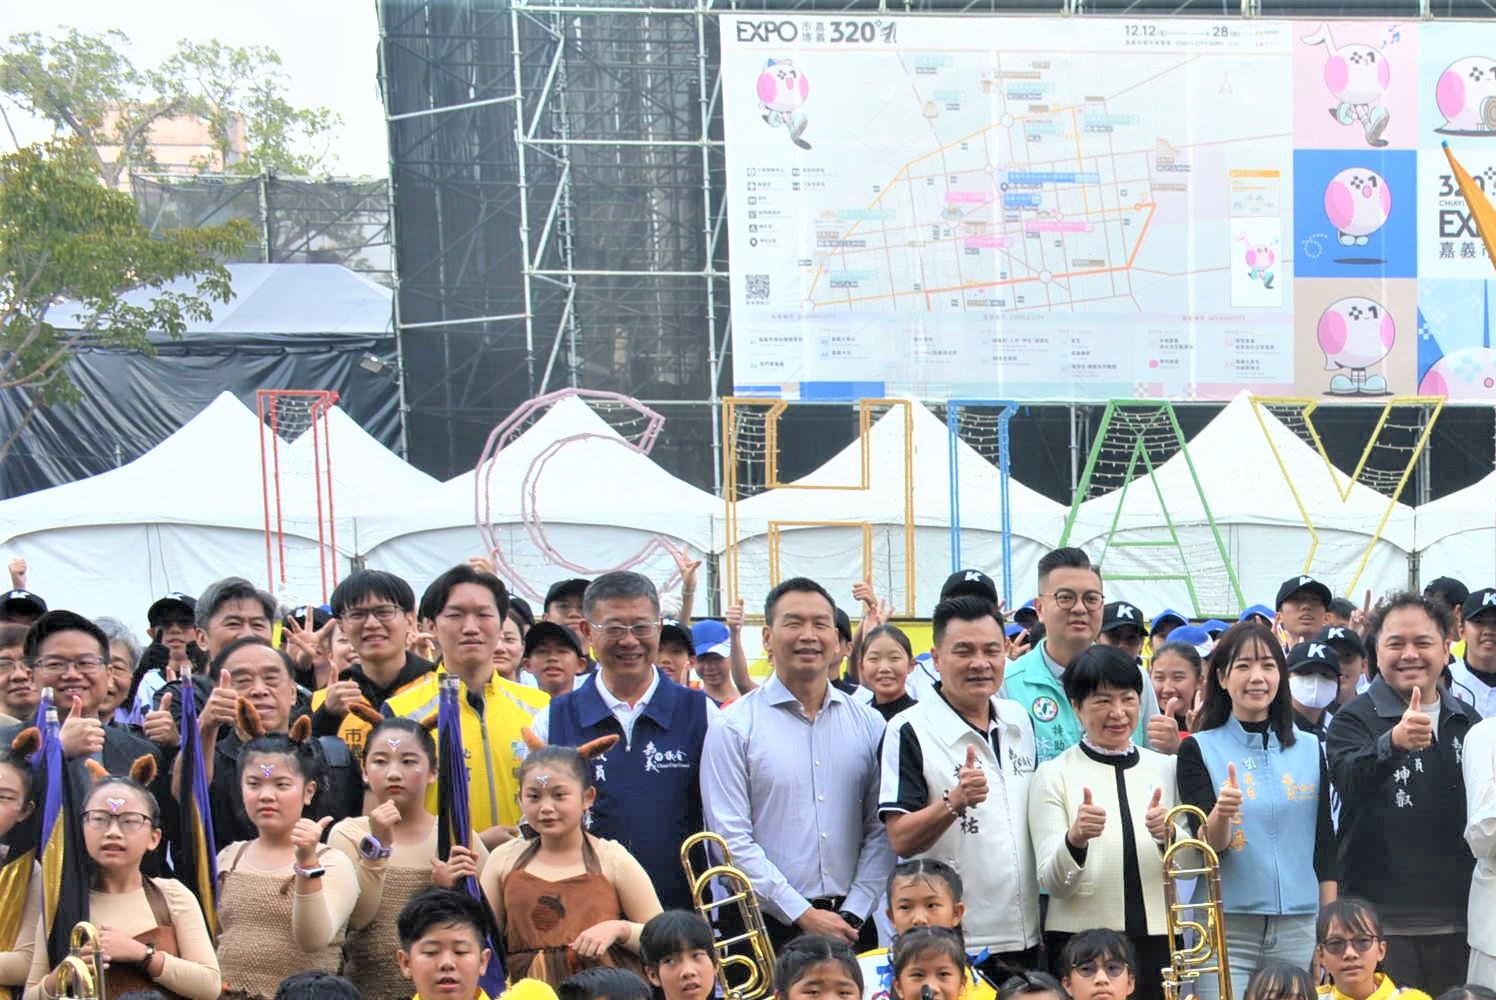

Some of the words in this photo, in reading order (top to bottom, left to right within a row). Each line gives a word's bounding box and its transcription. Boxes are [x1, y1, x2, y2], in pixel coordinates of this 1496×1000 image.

[736, 21, 798, 42] EXPO
[1125, 25, 1156, 37] 12.12
[1212, 26, 1229, 37] 28
[1440, 241, 1487, 259] 嘉義
[1116, 604, 1134, 619] K
[1327, 627, 1345, 639] K
[1307, 643, 1326, 658] K
